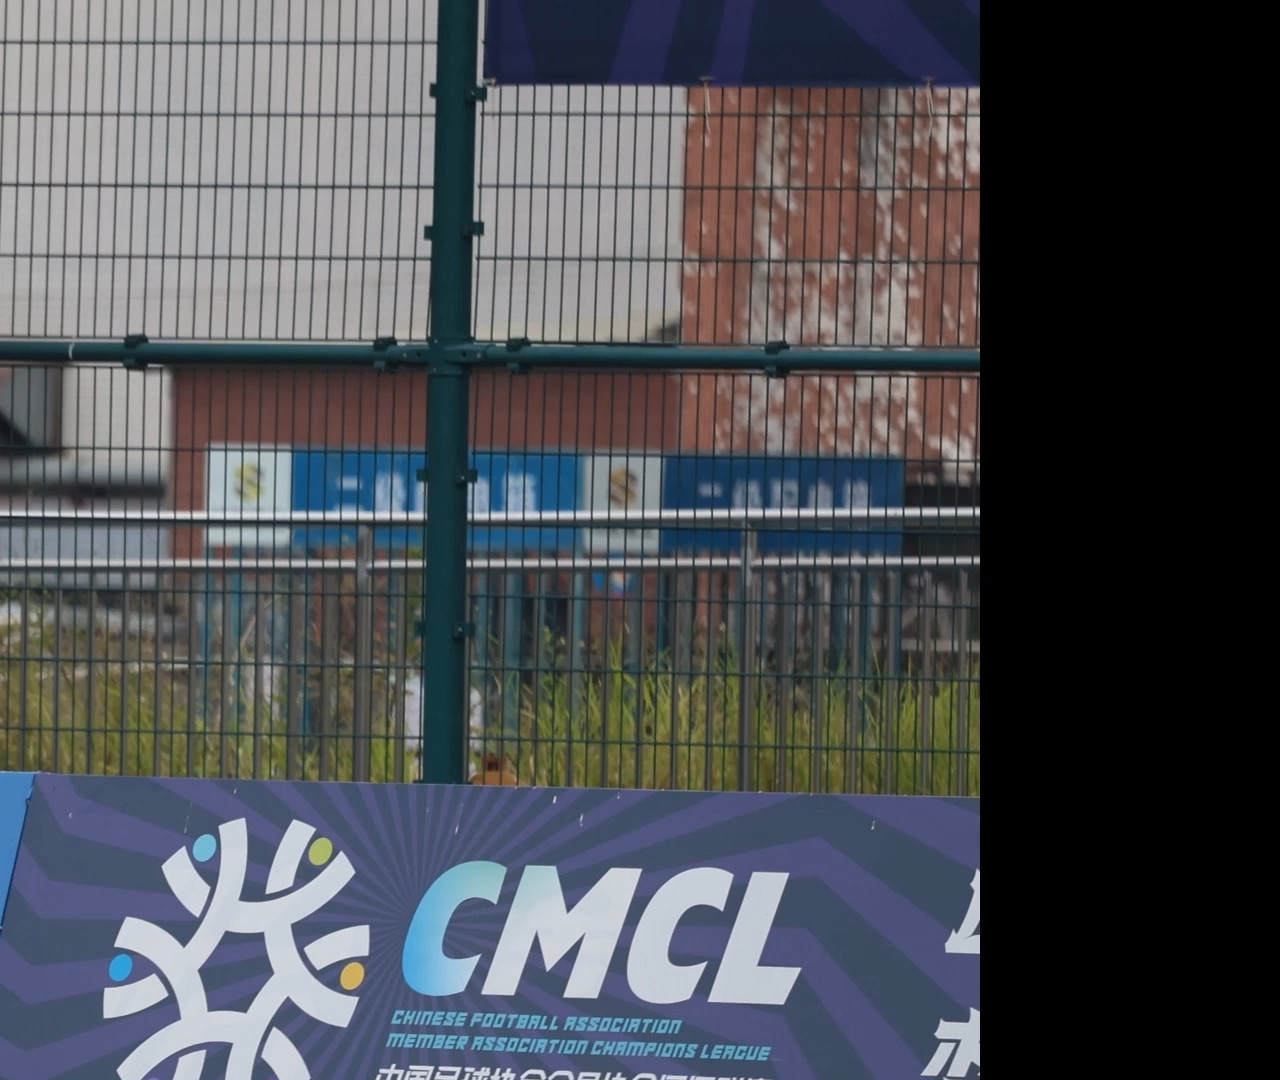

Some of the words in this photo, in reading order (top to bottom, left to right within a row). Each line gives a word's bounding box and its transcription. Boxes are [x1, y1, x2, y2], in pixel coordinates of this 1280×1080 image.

[401, 860, 803, 1006] CMCL
[391, 1009, 468, 1027] CHINESE
[469, 1012, 559, 1031] FOOTBALL
[563, 1016, 683, 1035] ASSOCIATION
[386, 1032, 470, 1050] MEMBER
[471, 1036, 589, 1055] ASSOCIATION
[590, 1040, 699, 1059] CHAMPIONS
[699, 1044, 772, 1062] LEAGUE
